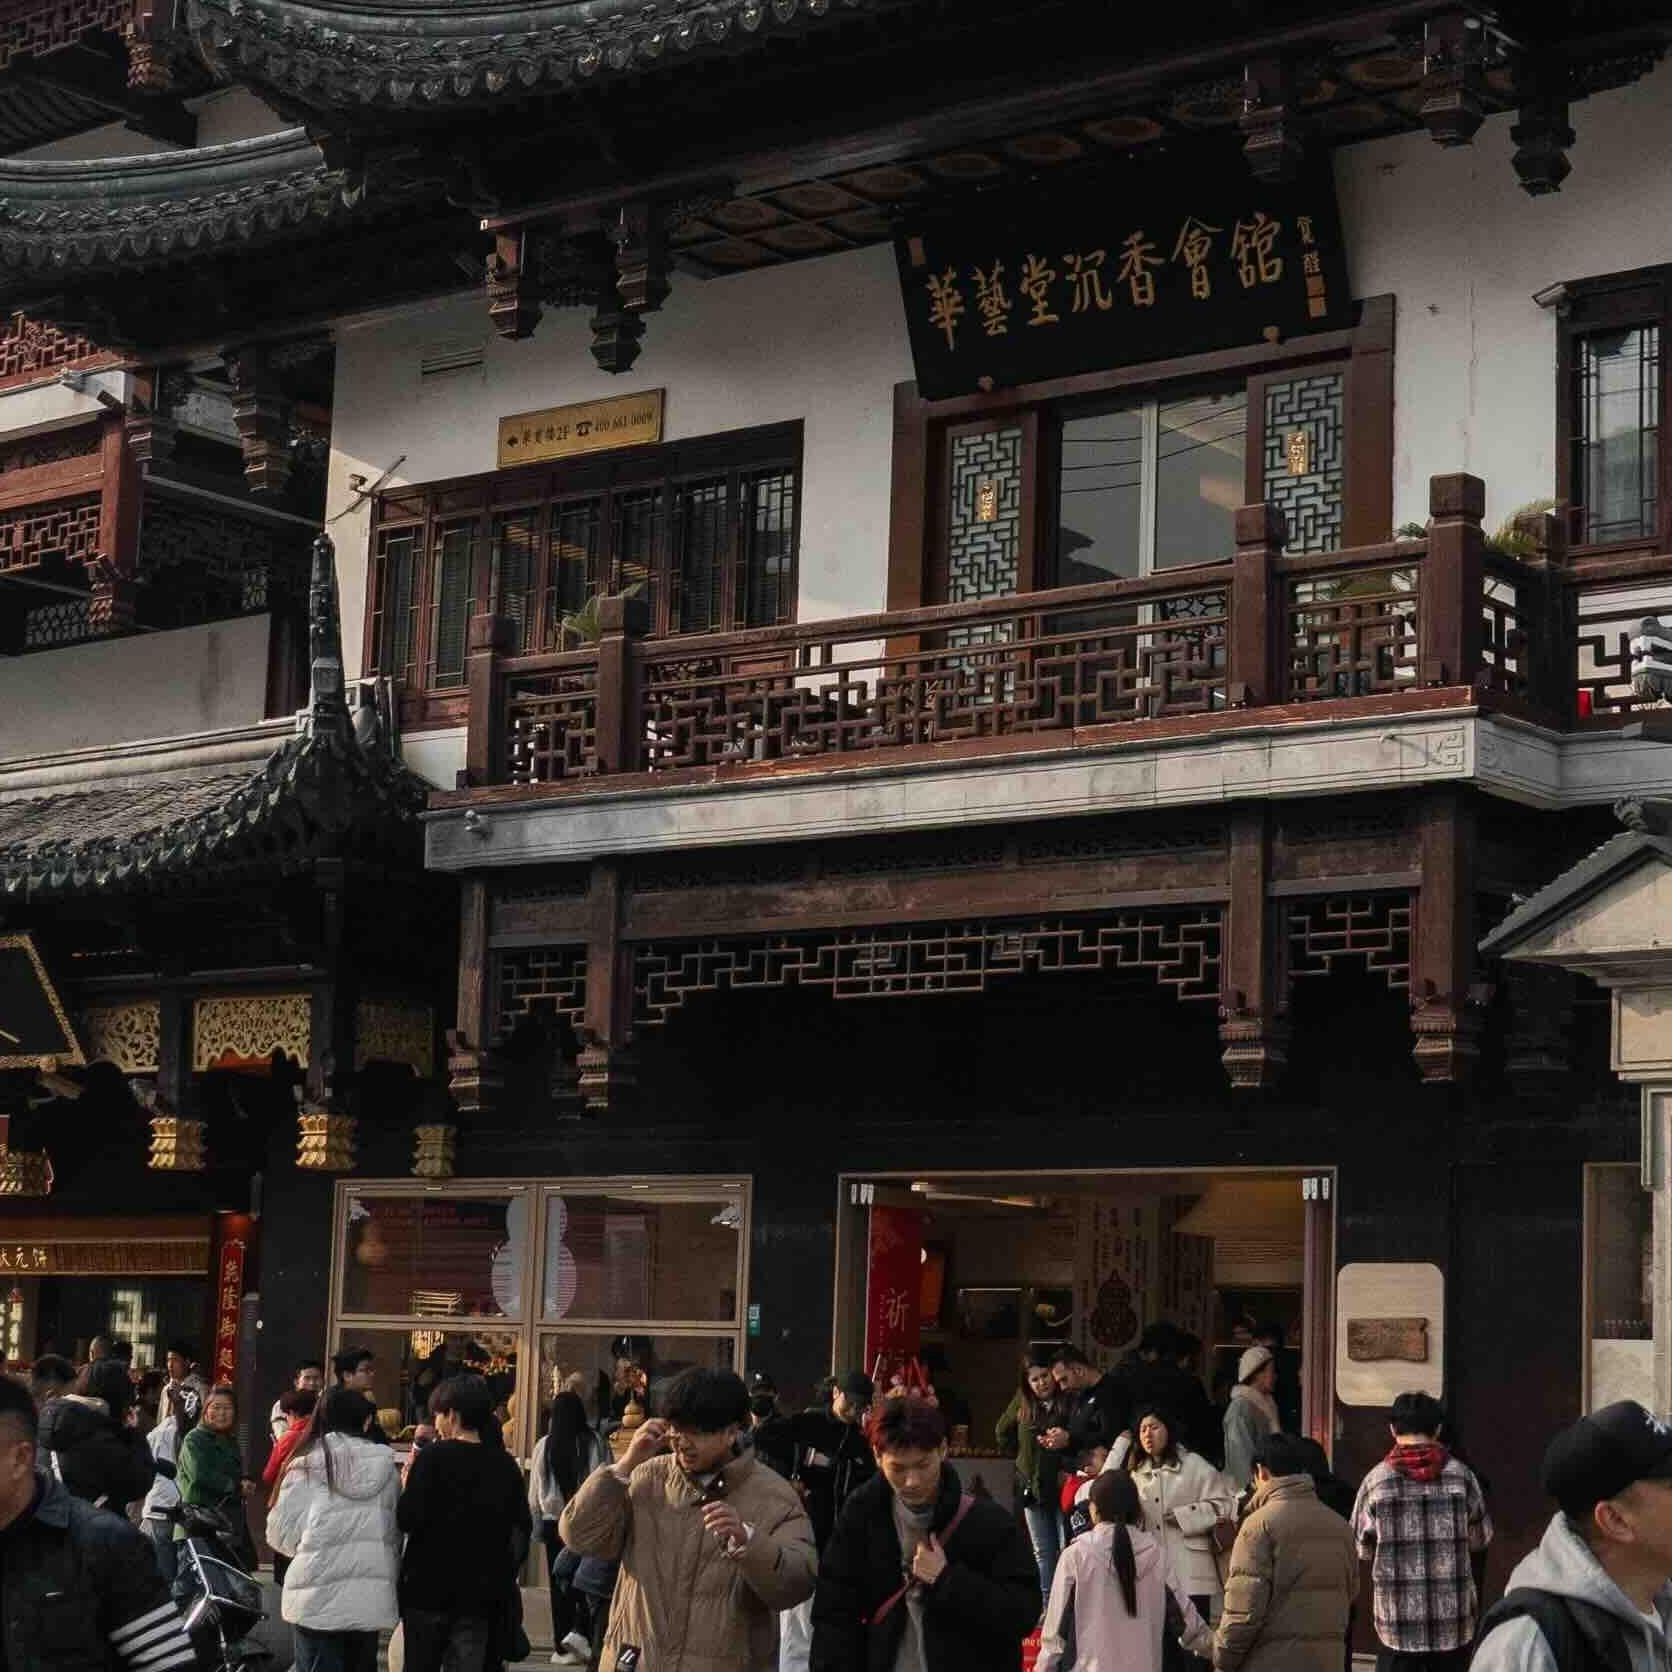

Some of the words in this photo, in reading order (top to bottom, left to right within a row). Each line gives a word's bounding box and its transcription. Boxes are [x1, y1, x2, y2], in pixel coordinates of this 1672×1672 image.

[925, 212, 1285, 351] 華藝堂沉香會館
